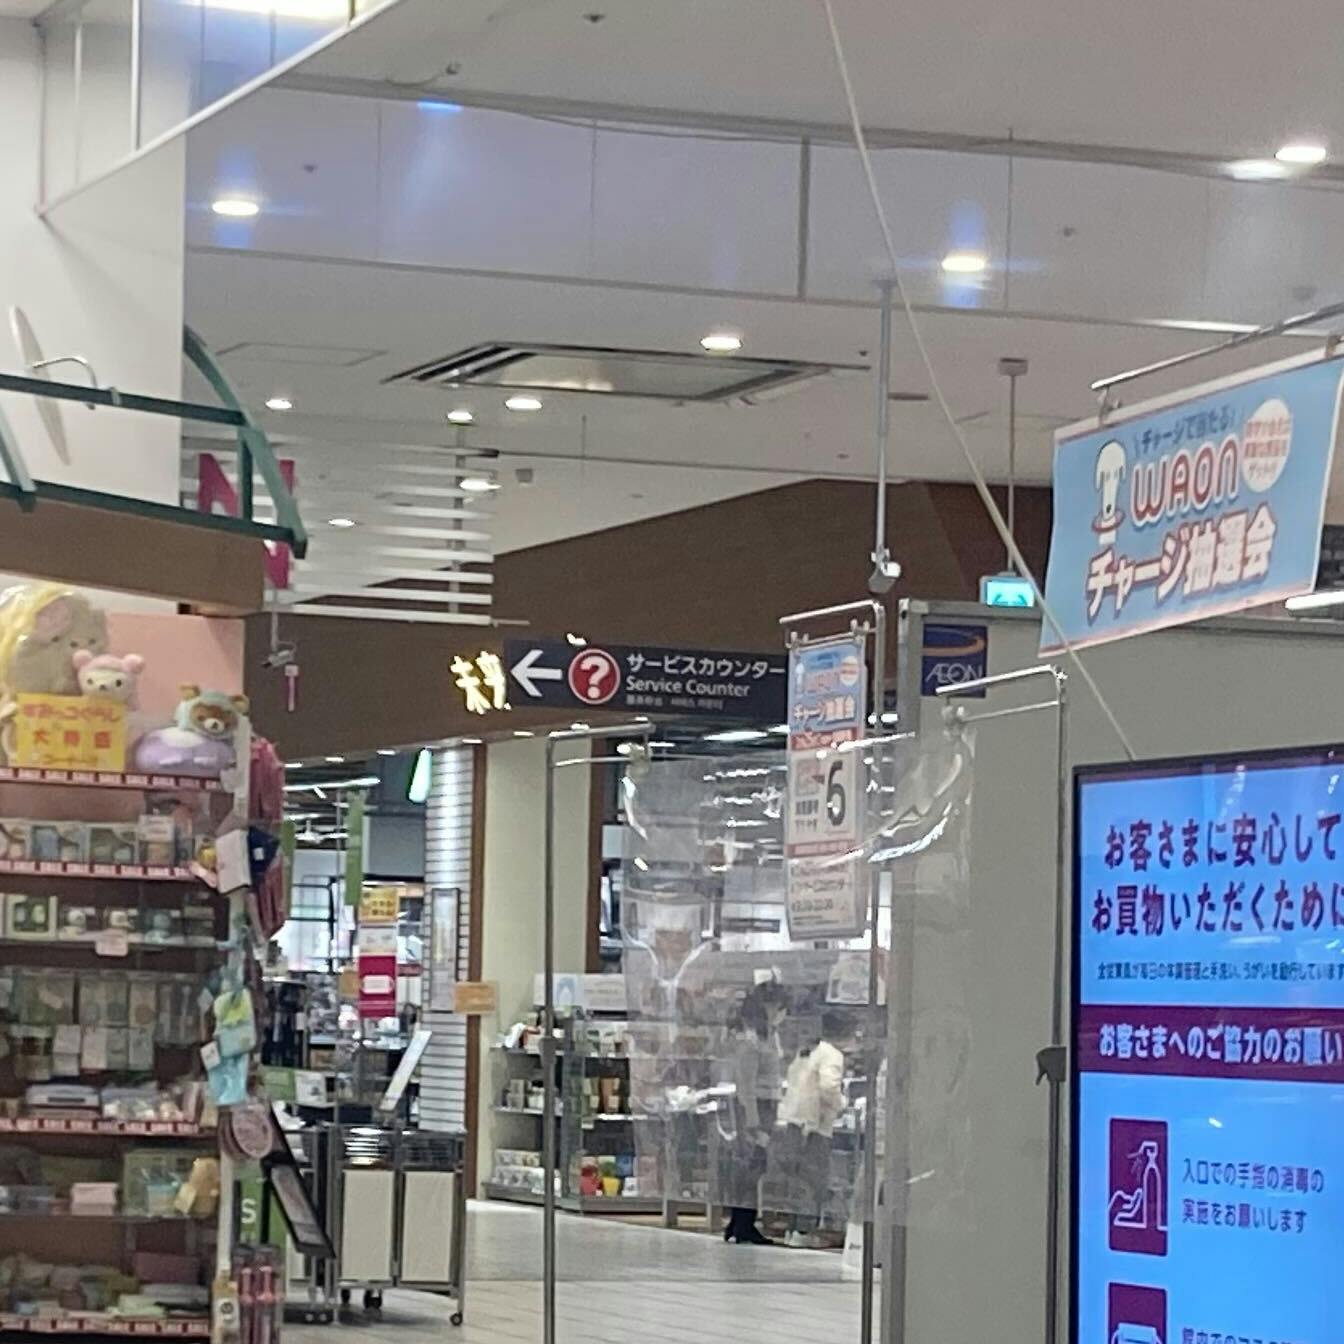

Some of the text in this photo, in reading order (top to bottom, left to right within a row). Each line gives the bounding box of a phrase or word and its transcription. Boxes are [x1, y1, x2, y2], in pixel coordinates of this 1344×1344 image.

[626, 653, 785, 679] サービスカウンター
[626, 675, 750, 697] Service Counter
[1104, 812, 1343, 872] お客さまに安心して
[1099, 1023, 1344, 1066] お客さまへのご協力のお願い
[1182, 1199, 1307, 1234] 実施をお願いします
